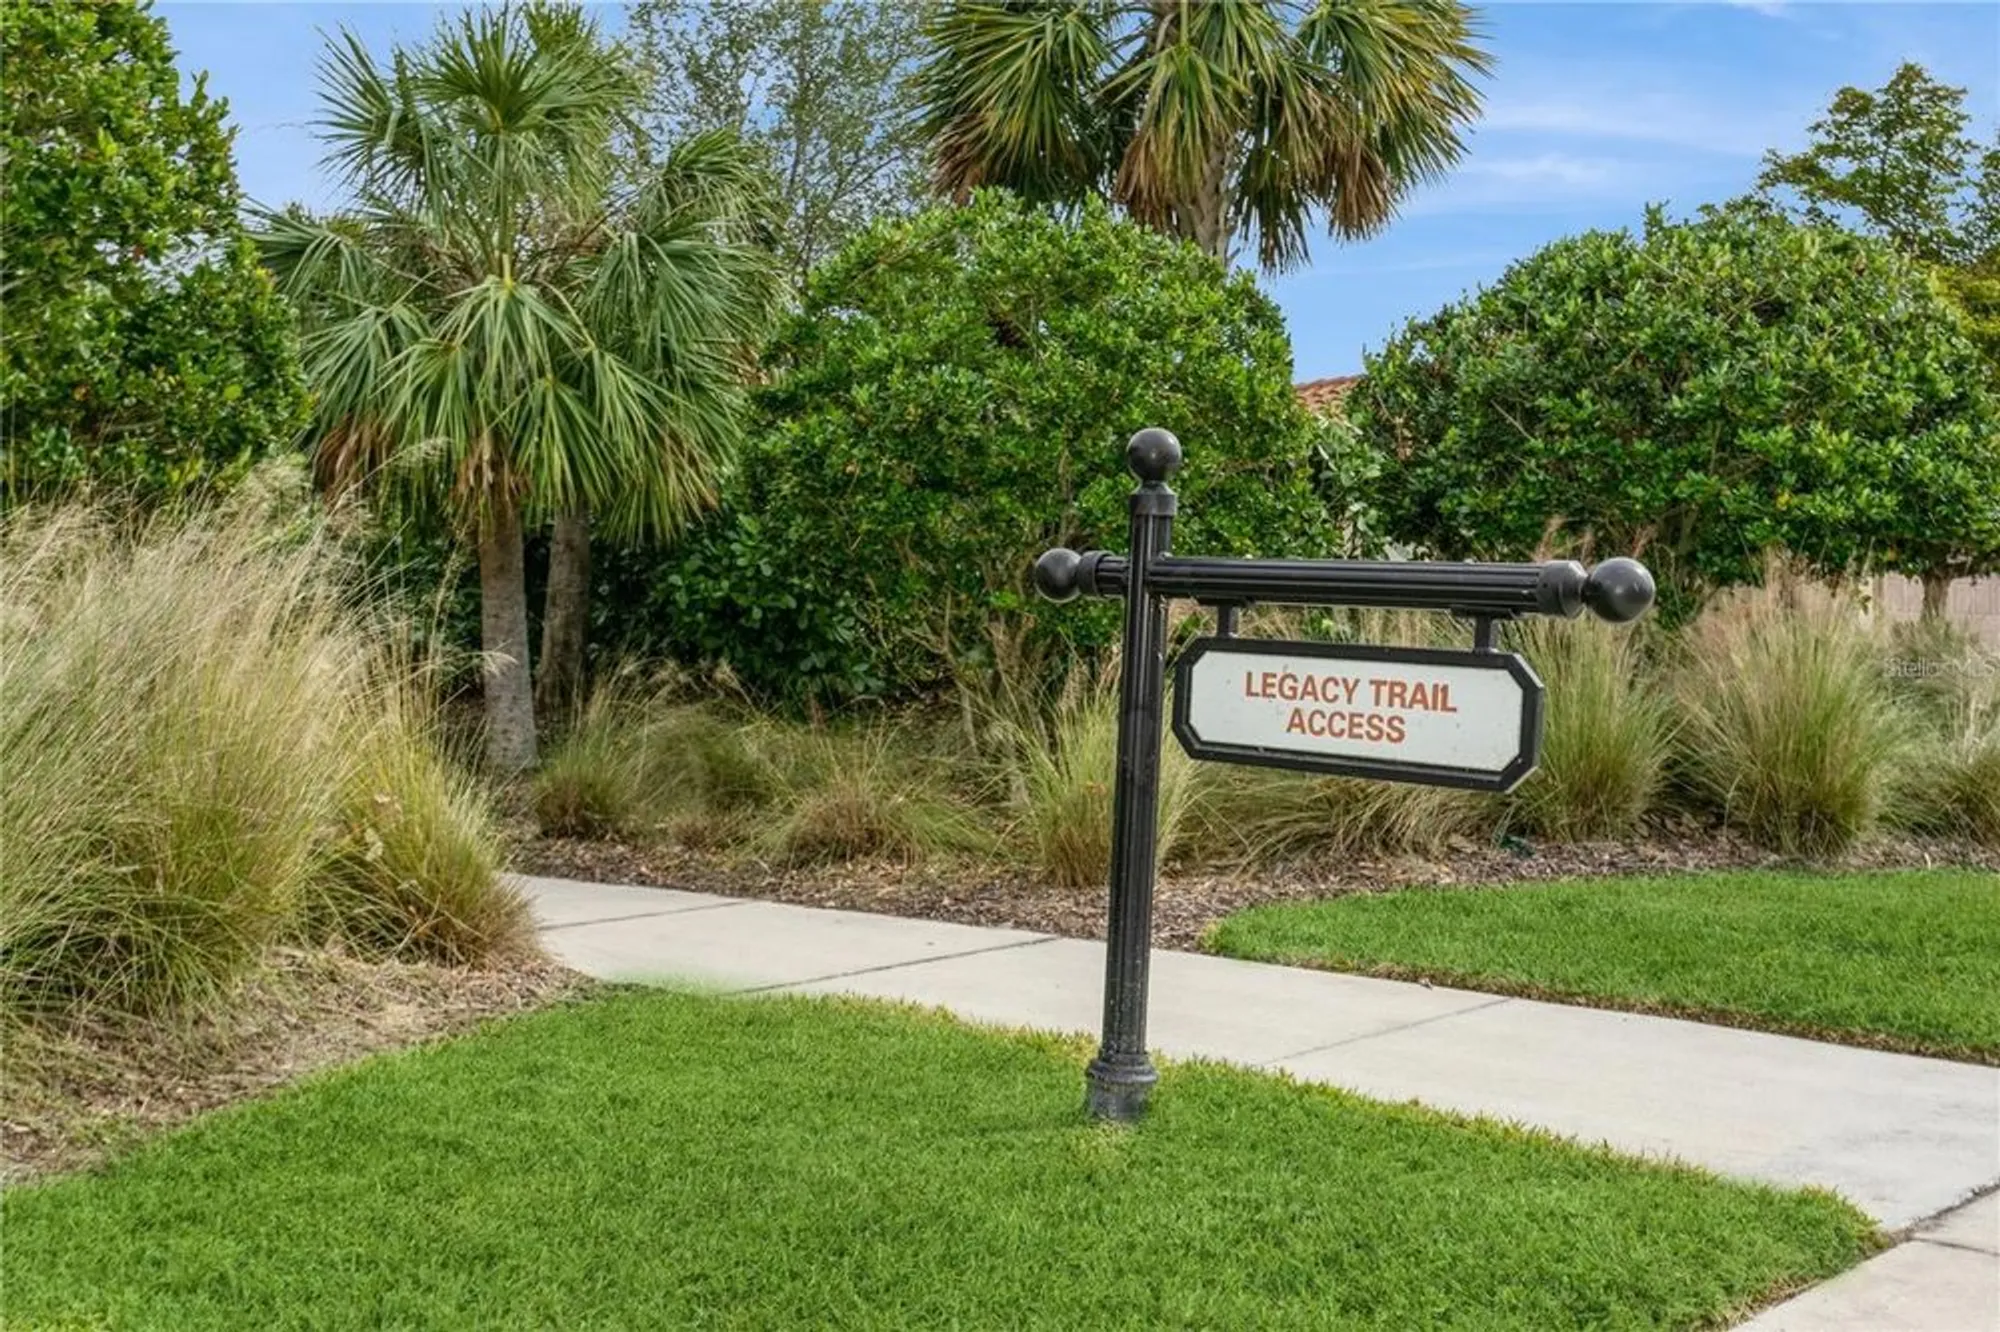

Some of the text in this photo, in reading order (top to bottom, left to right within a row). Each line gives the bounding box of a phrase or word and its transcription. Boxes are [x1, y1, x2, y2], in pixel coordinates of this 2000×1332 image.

[1244, 670, 1458, 713] LEGACY TRAIL
[1285, 706, 1406, 744] ACCESS
